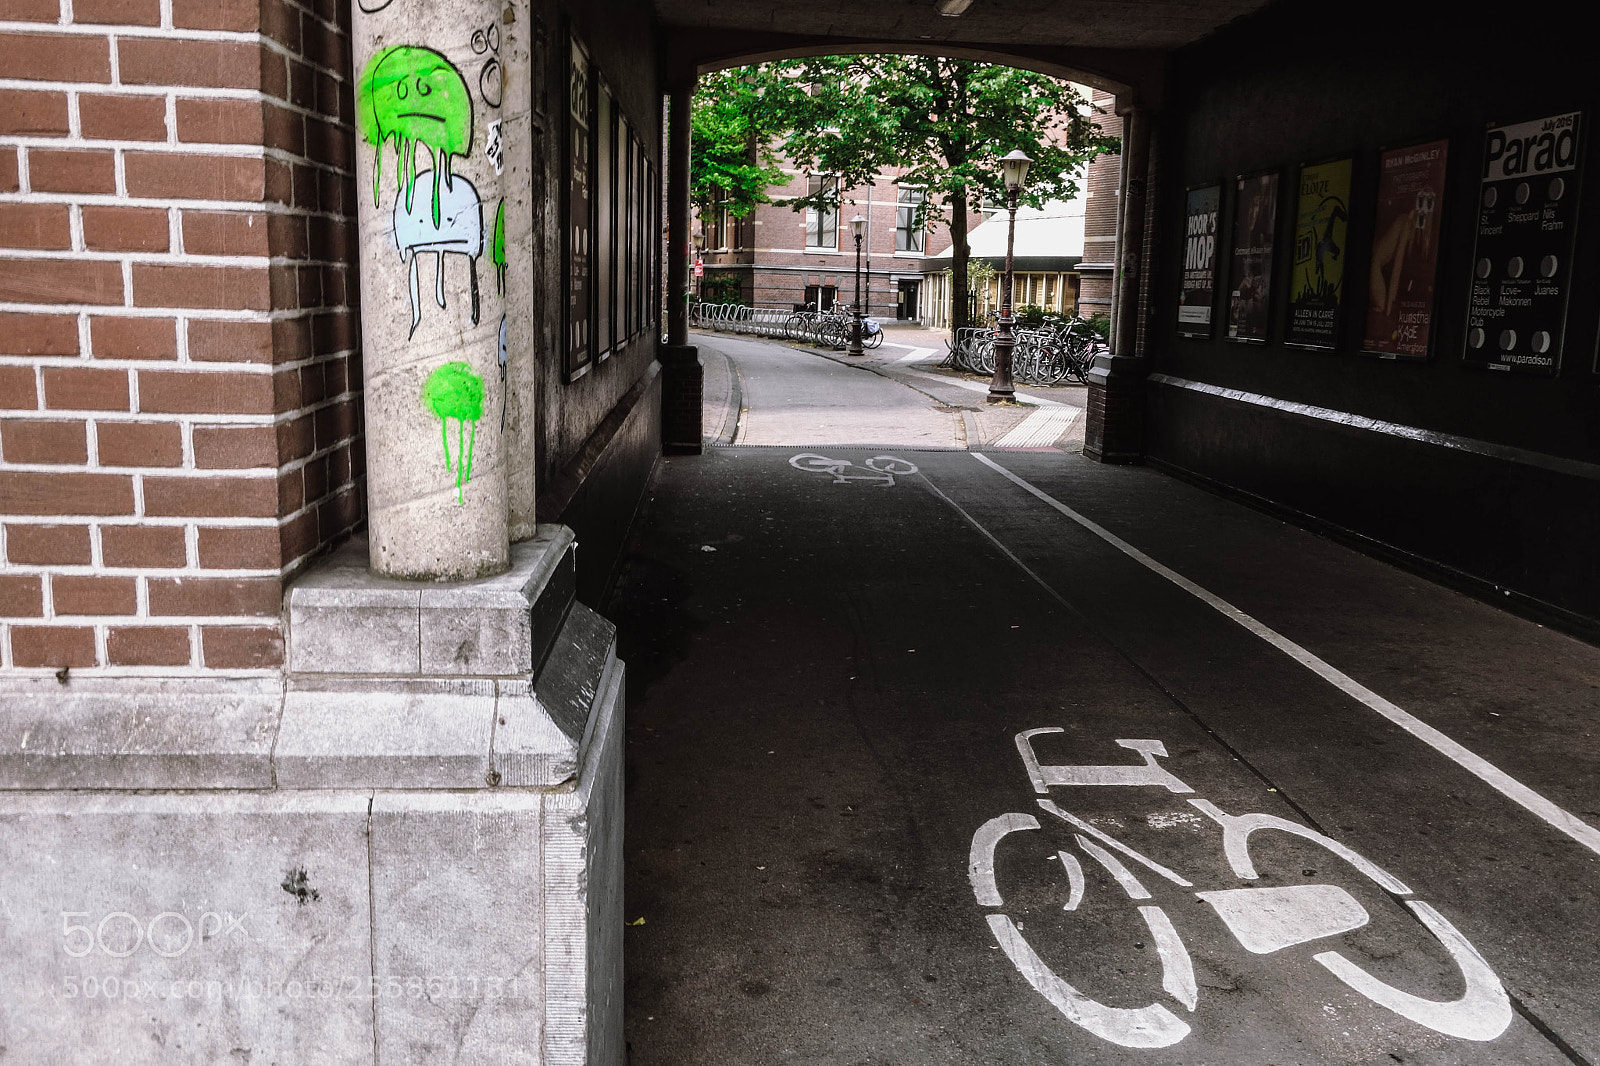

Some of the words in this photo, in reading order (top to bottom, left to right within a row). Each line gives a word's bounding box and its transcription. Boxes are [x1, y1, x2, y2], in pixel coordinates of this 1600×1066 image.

[1541, 119, 1556, 132] July
[1556, 115, 1573, 129] 2015
[1483, 113, 1580, 178] Parad
[1385, 156, 1403, 168] RYAN
[1404, 148, 1441, 165] McGINLEY
[1508, 210, 1540, 224] Sheppard
[1543, 208, 1556, 220] Nils
[1480, 225, 1503, 236] Vincent
[1541, 219, 1564, 232] Frahm
[1185, 235, 1214, 270] MOP
[1473, 285, 1491, 295] Black
[1534, 285, 1559, 296] Juanes
[1472, 295, 1490, 305] Rebel
[1499, 296, 1532, 306] Makonnen
[1471, 306, 1505, 318] Motorcycle
[1470, 316, 1484, 327] Club
